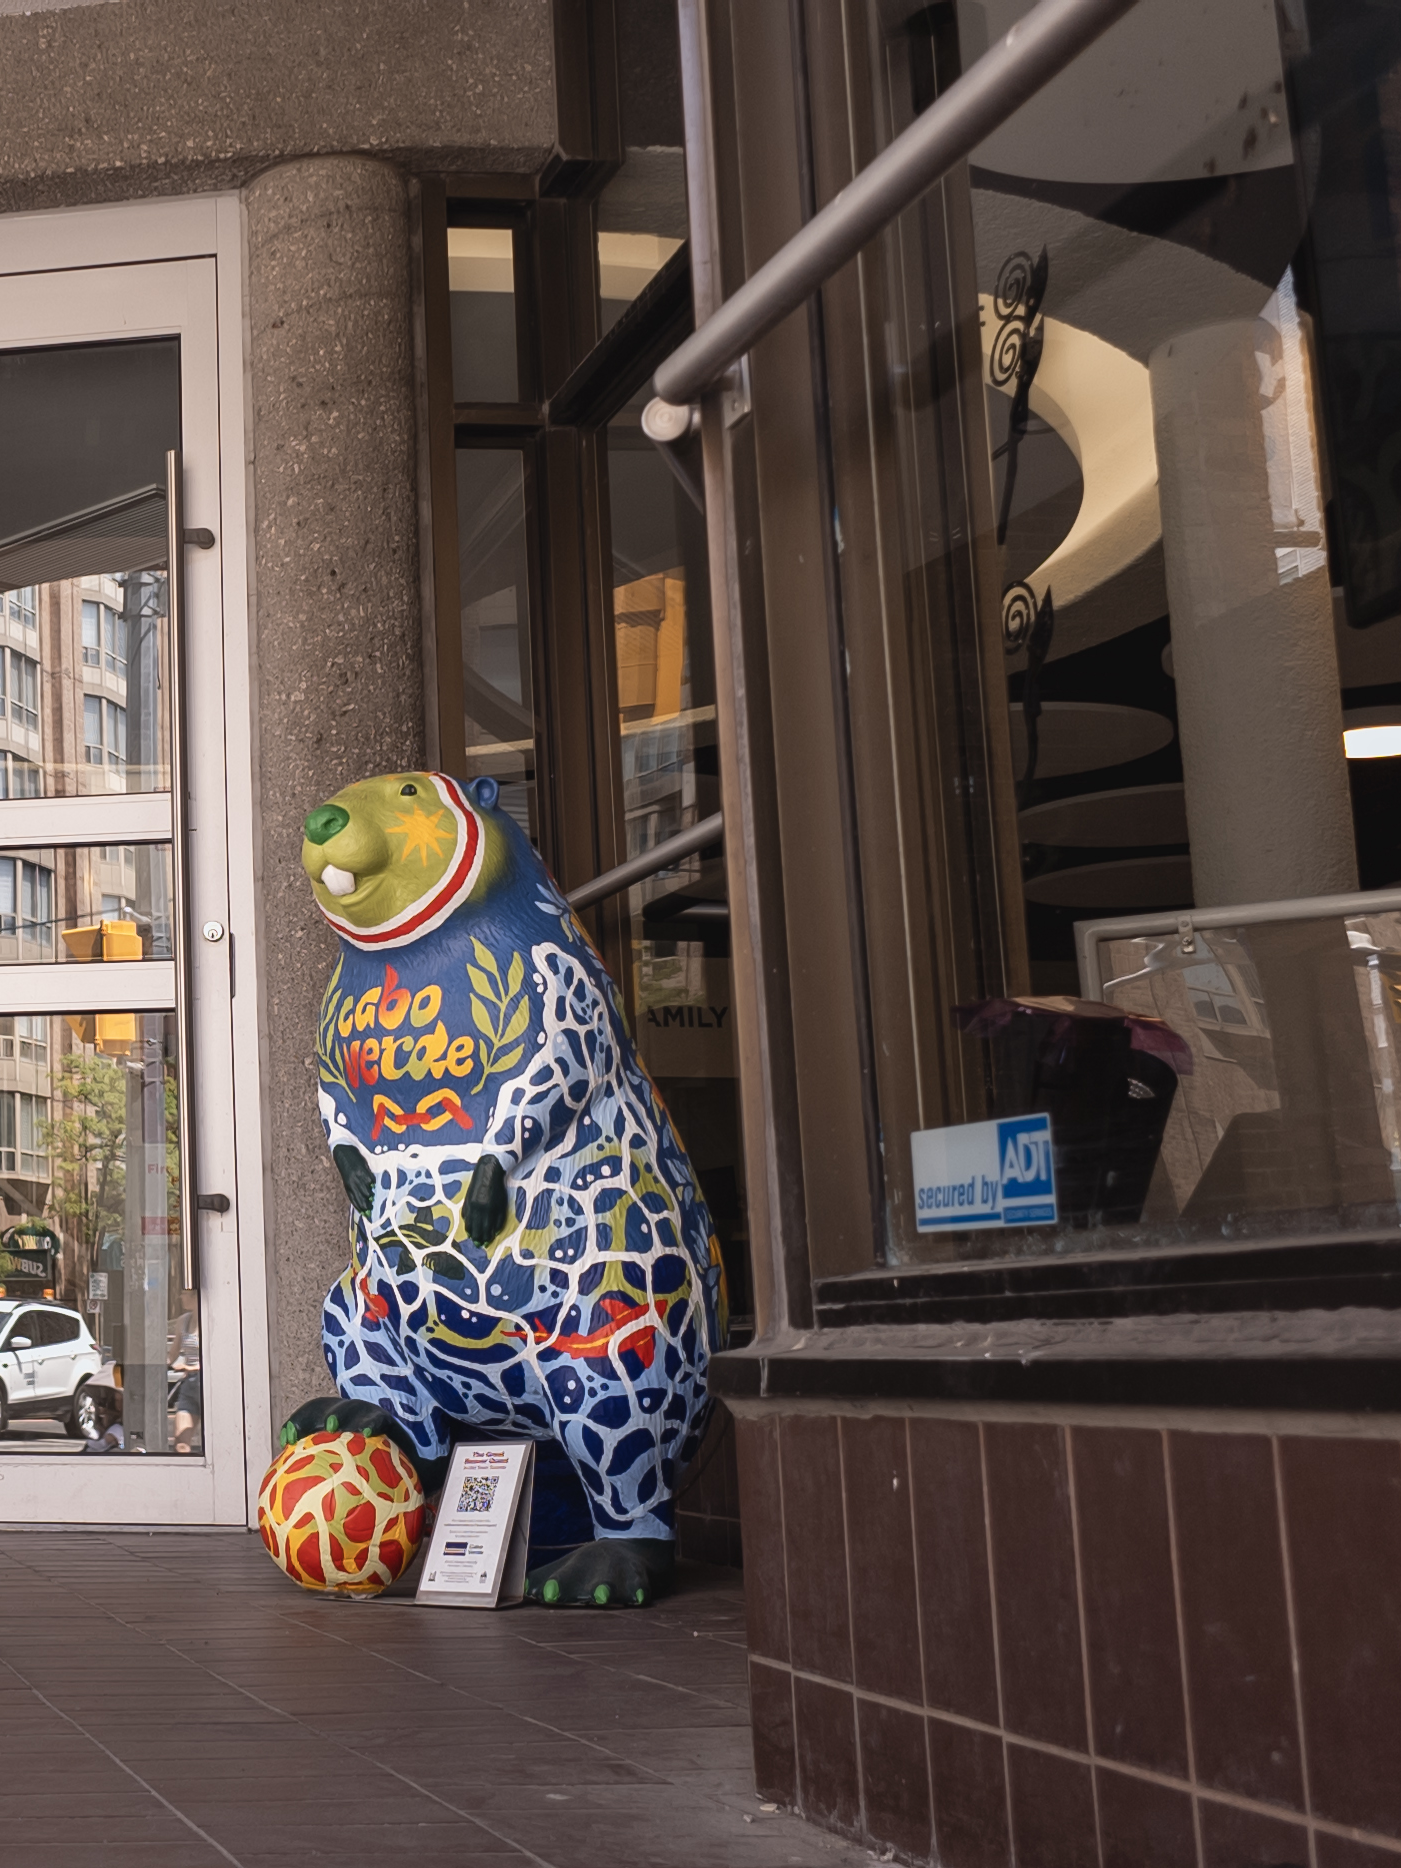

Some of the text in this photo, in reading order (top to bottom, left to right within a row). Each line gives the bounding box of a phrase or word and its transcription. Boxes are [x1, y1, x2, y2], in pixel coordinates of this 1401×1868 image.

[918, 1130, 1051, 1210] secured by ADT
